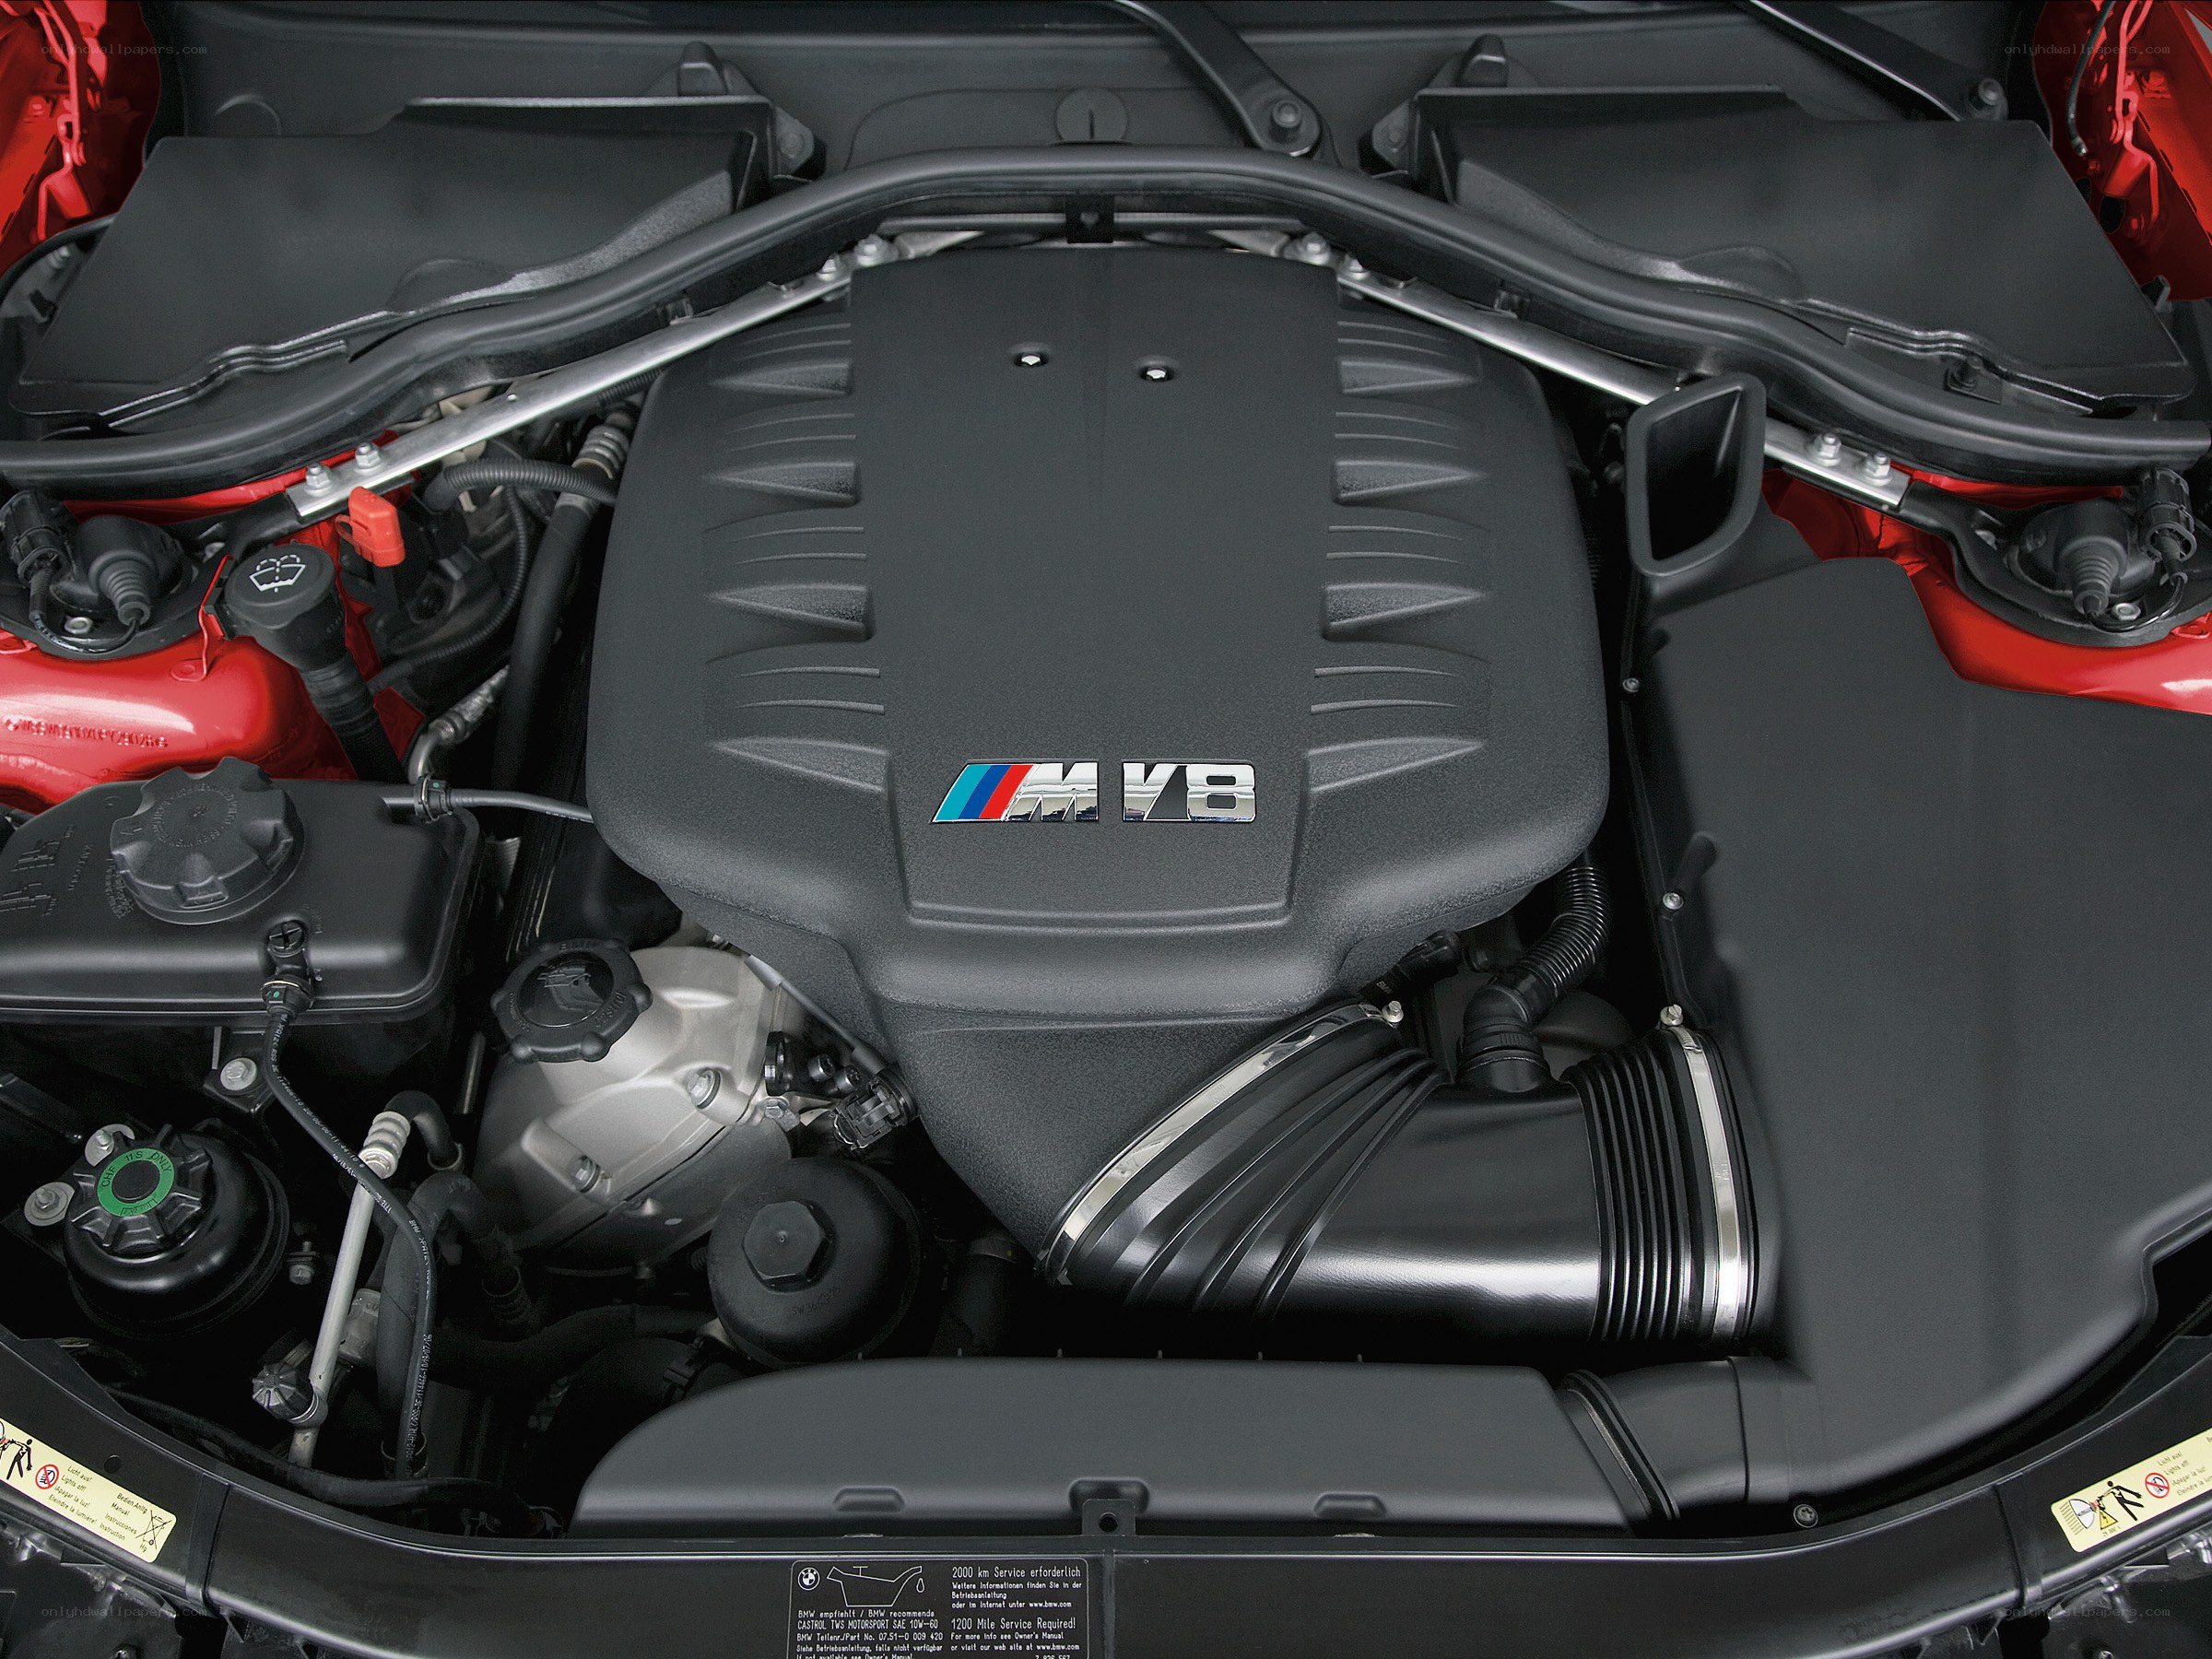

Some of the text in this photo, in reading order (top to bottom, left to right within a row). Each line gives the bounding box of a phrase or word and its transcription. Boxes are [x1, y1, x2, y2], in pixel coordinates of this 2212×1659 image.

[1003, 762, 1257, 822] M V8
[101, 1165, 116, 1187] CHF
[150, 1152, 171, 1171] ONLY
[67, 1465, 92, 1482] Licht aus!
[61, 1475, 76, 1486] Lights
[69, 1504, 75, 1512] la
[79, 1499, 90, 1508] luz!
[112, 1502, 131, 1516] Manual
[105, 1513, 136, 1535] Instrucciones
[100, 1523, 125, 1540] Instruction
[140, 1543, 147, 1552] Hg
[952, 1566, 1081, 1578] 2000 km Service erforderlich
[952, 1591, 1007, 1599] Betriebsanleitung
[819, 1610, 855, 1619] empfiehlt
[868, 1609, 885, 1618] BMW
[890, 1609, 935, 1618] recommends
[798, 1619, 938, 1630] CASTROL TWS MOTORSPORT SAE 10W-60
[951, 1617, 1076, 1631] 1200 Mile Service Required!
[796, 1633, 813, 1641] BMW
[817, 1633, 861, 1641] Teilenr./Part
[913, 1632, 926, 1641] 009
[930, 1632, 943, 1641] 420
[1041, 1631, 1064, 1640] Manual
[796, 1644, 813, 1653] Siehe
[817, 1644, 872, 1653] Betriebsanleitung,
[913, 1644, 943, 1653] verfügbar
